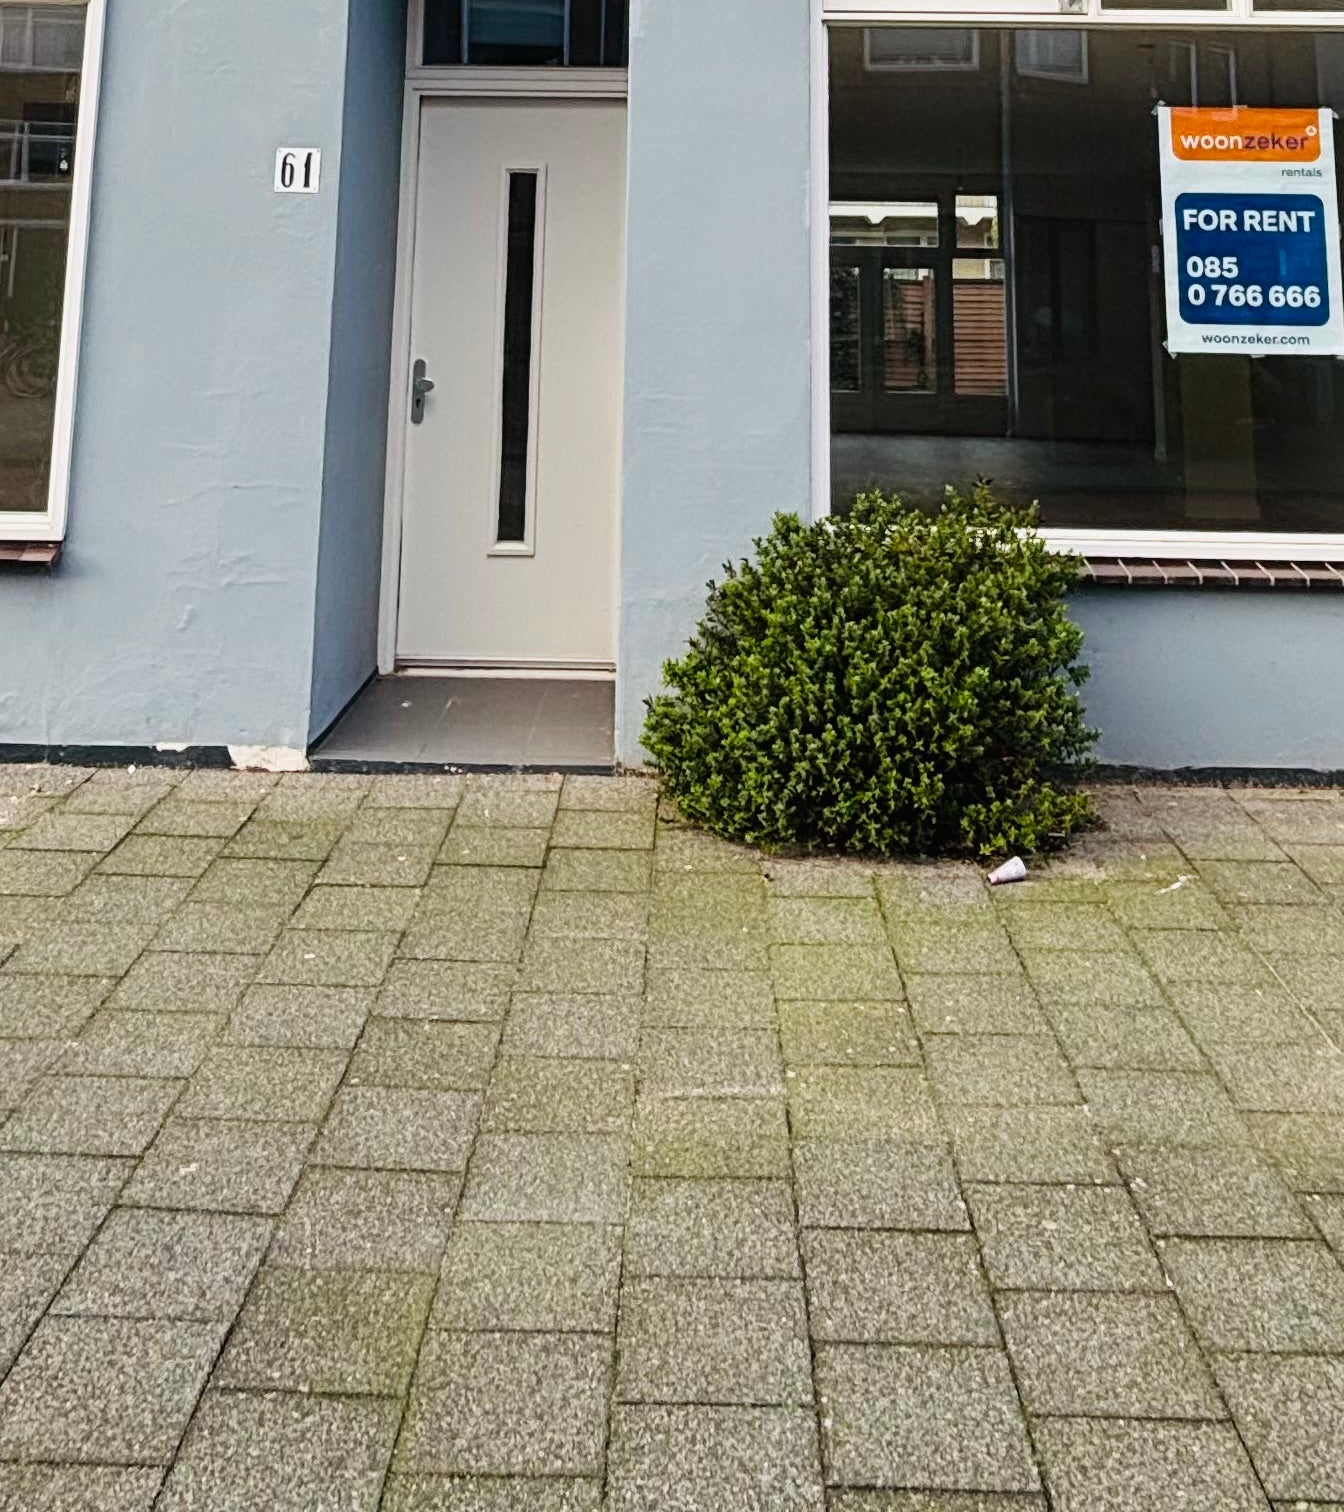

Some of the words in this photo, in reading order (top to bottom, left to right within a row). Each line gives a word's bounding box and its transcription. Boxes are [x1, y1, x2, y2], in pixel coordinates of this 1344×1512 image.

[1179, 132, 1309, 151] woonzeker
[280, 152, 313, 188] 61
[1281, 167, 1323, 177] rentals
[1183, 209, 1237, 231] FOR
[1243, 210, 1316, 233] RENT
[1186, 255, 1239, 278] 085
[1187, 284, 1206, 306] 0
[1211, 284, 1263, 307] 766
[1268, 285, 1322, 308] 666
[1201, 333, 1311, 346] woonzeker.com
